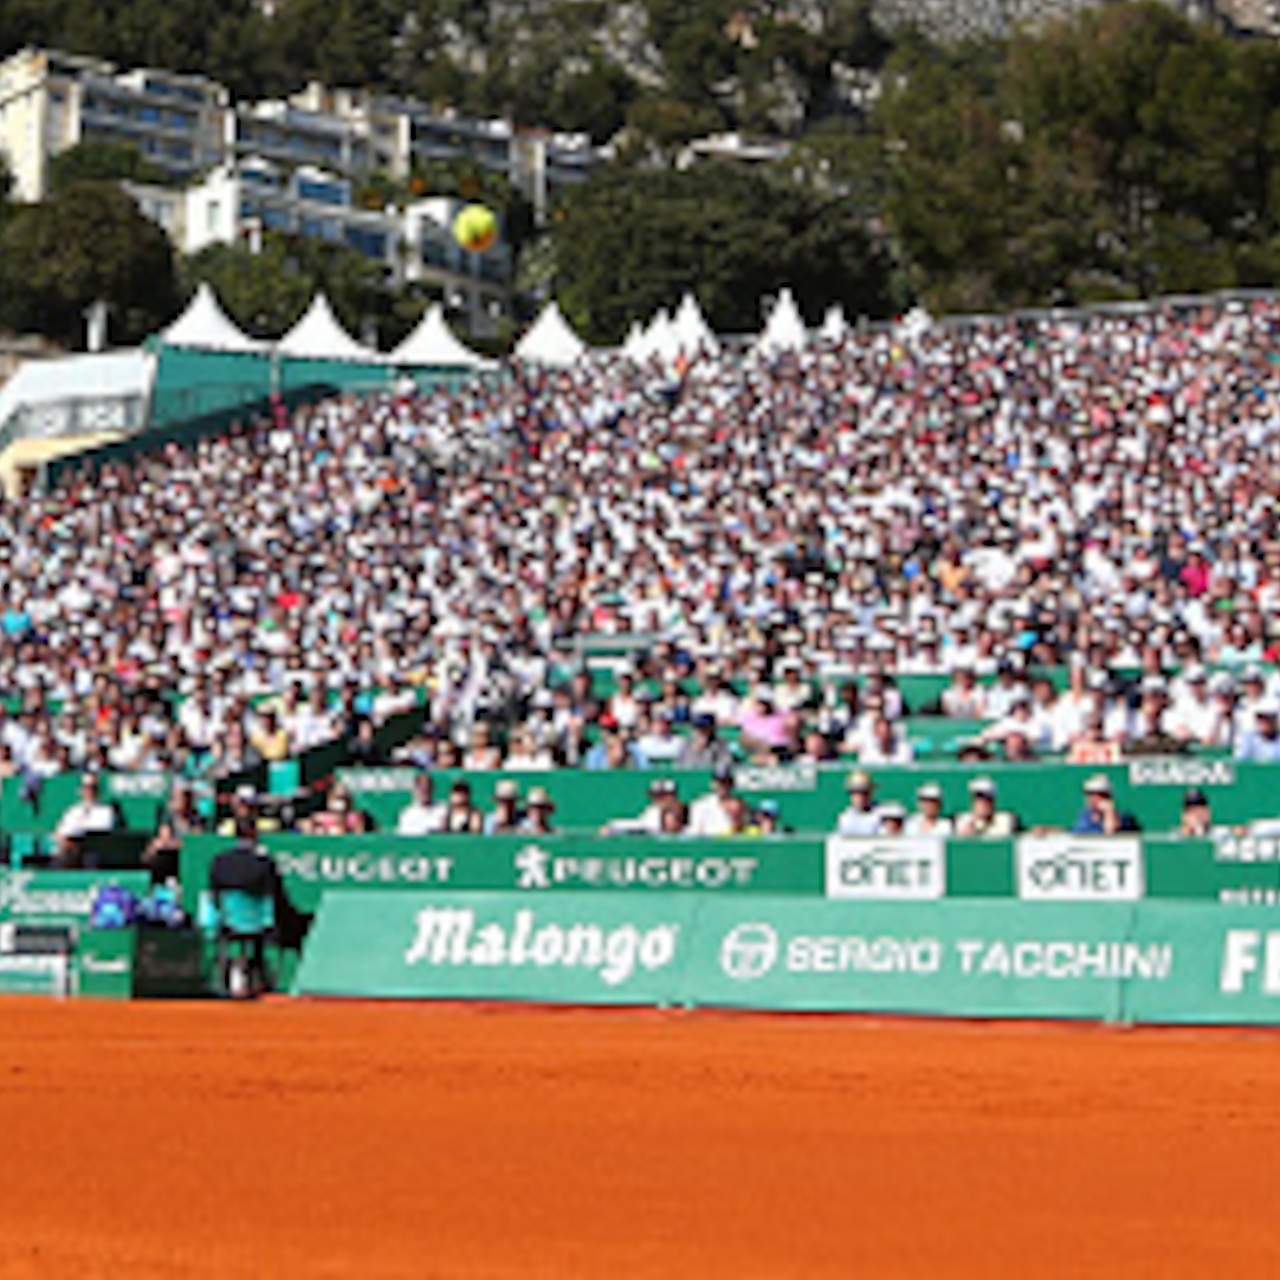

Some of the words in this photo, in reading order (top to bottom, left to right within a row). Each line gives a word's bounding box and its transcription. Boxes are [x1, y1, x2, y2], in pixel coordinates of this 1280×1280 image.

[552, 856, 758, 886] PEUGEOT
[406, 906, 679, 984] Malongo
[785, 936, 942, 973] SERGIO
[956, 941, 1172, 979] TACCHINI
